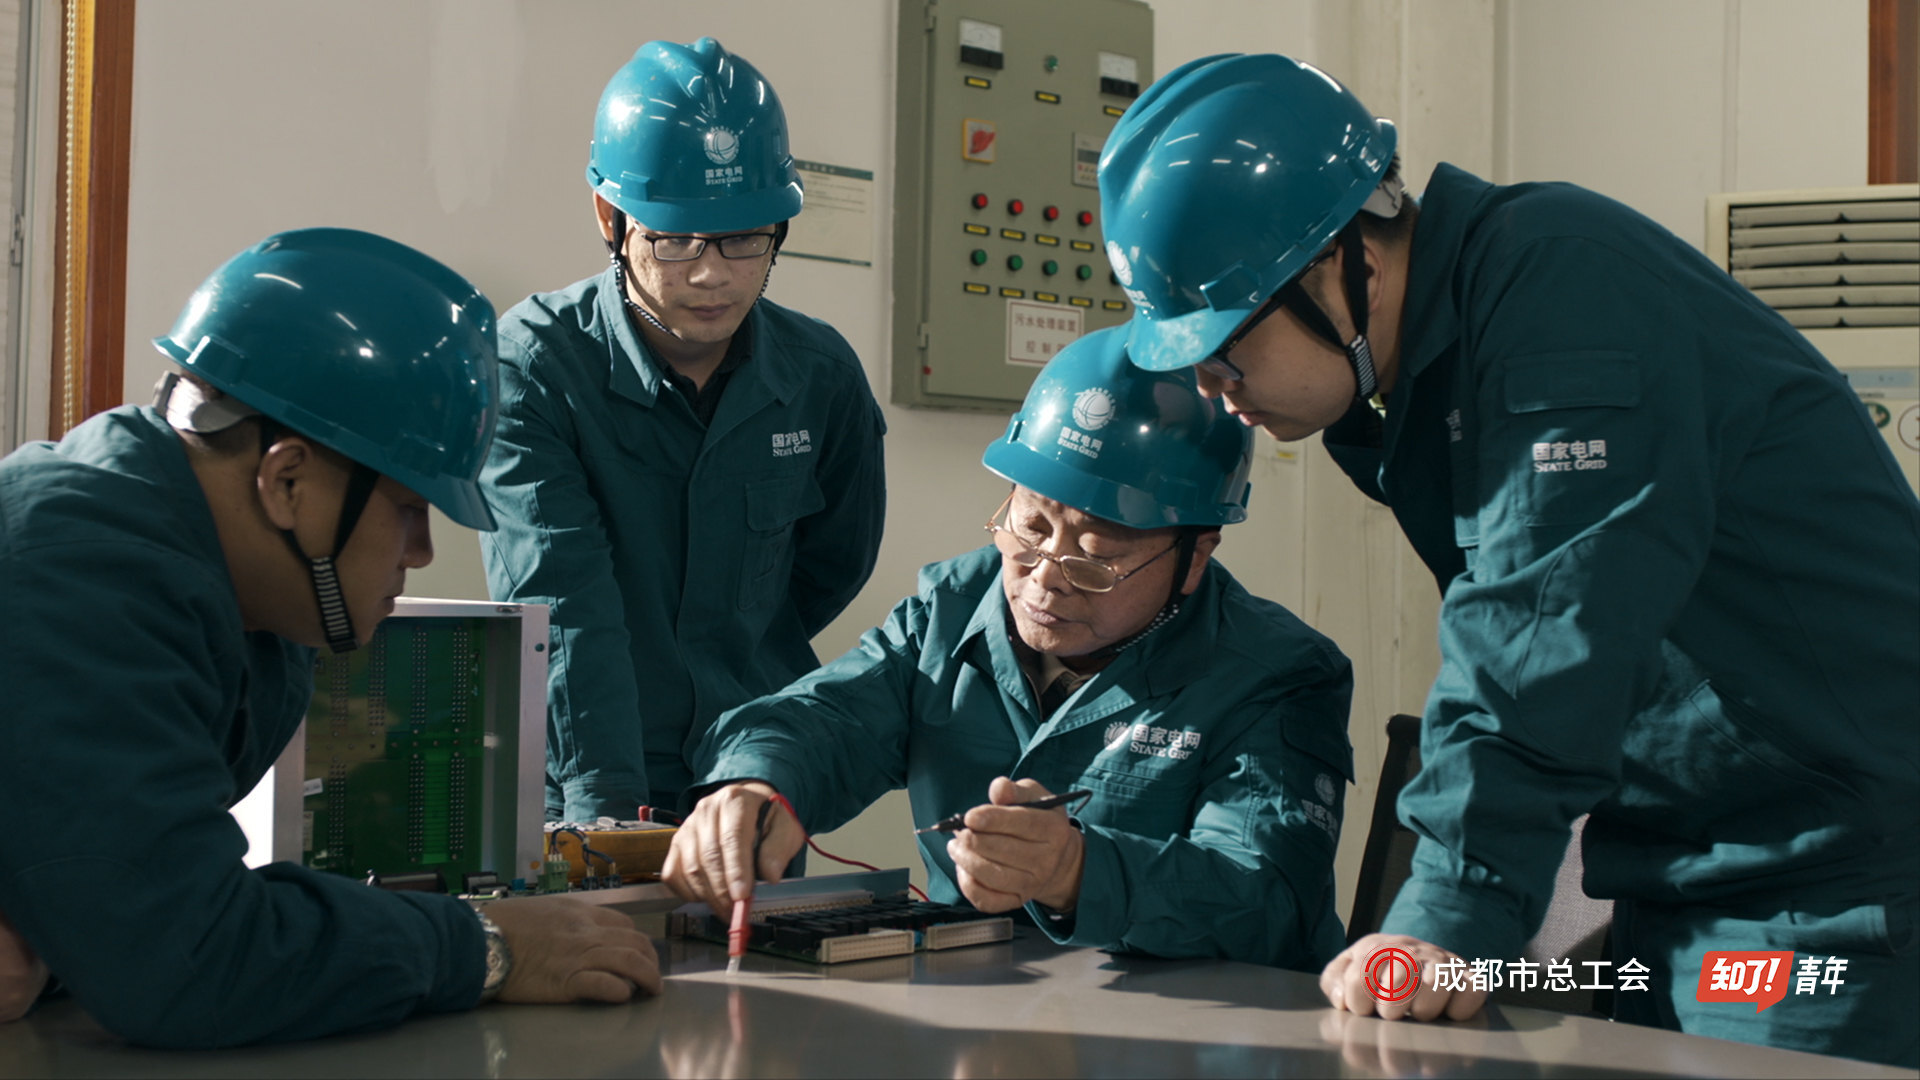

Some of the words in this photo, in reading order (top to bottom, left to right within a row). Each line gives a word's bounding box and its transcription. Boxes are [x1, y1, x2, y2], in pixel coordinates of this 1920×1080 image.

[705, 166, 743, 178] 国家电网
[1060, 426, 1103, 452] 国家电网
[1532, 440, 1606, 460] 国家电网
[1533, 461, 1573, 473] STATE
[1574, 459, 1607, 470] GRID
[1131, 724, 1201, 749] 国家电网
[1130, 741, 1167, 757] STATE
